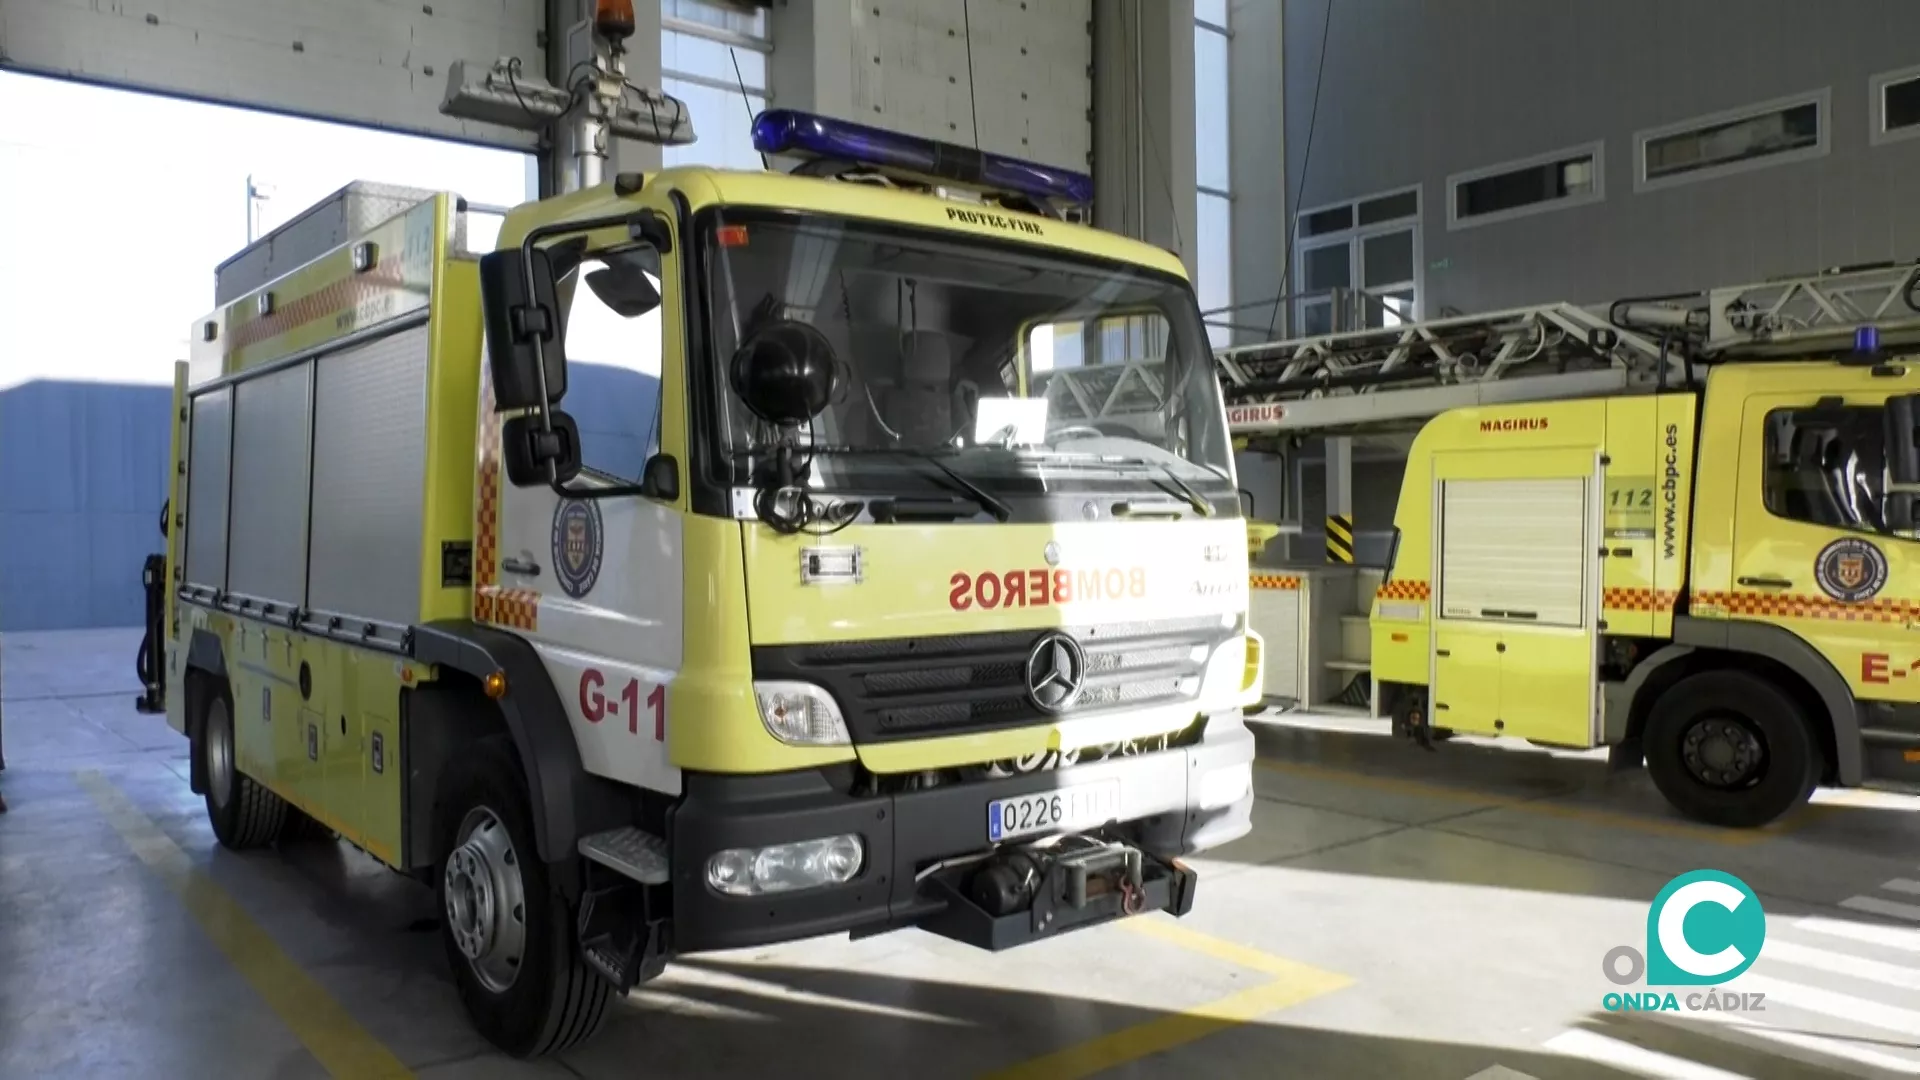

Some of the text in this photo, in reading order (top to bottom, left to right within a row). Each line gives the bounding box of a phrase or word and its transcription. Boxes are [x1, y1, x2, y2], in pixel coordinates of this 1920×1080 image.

[1480, 417, 1549, 432] MAGIRUS
[1610, 489, 1652, 506] 112
[1664, 423, 1680, 560] www.cbpc.es
[579, 668, 665, 743] G-11
